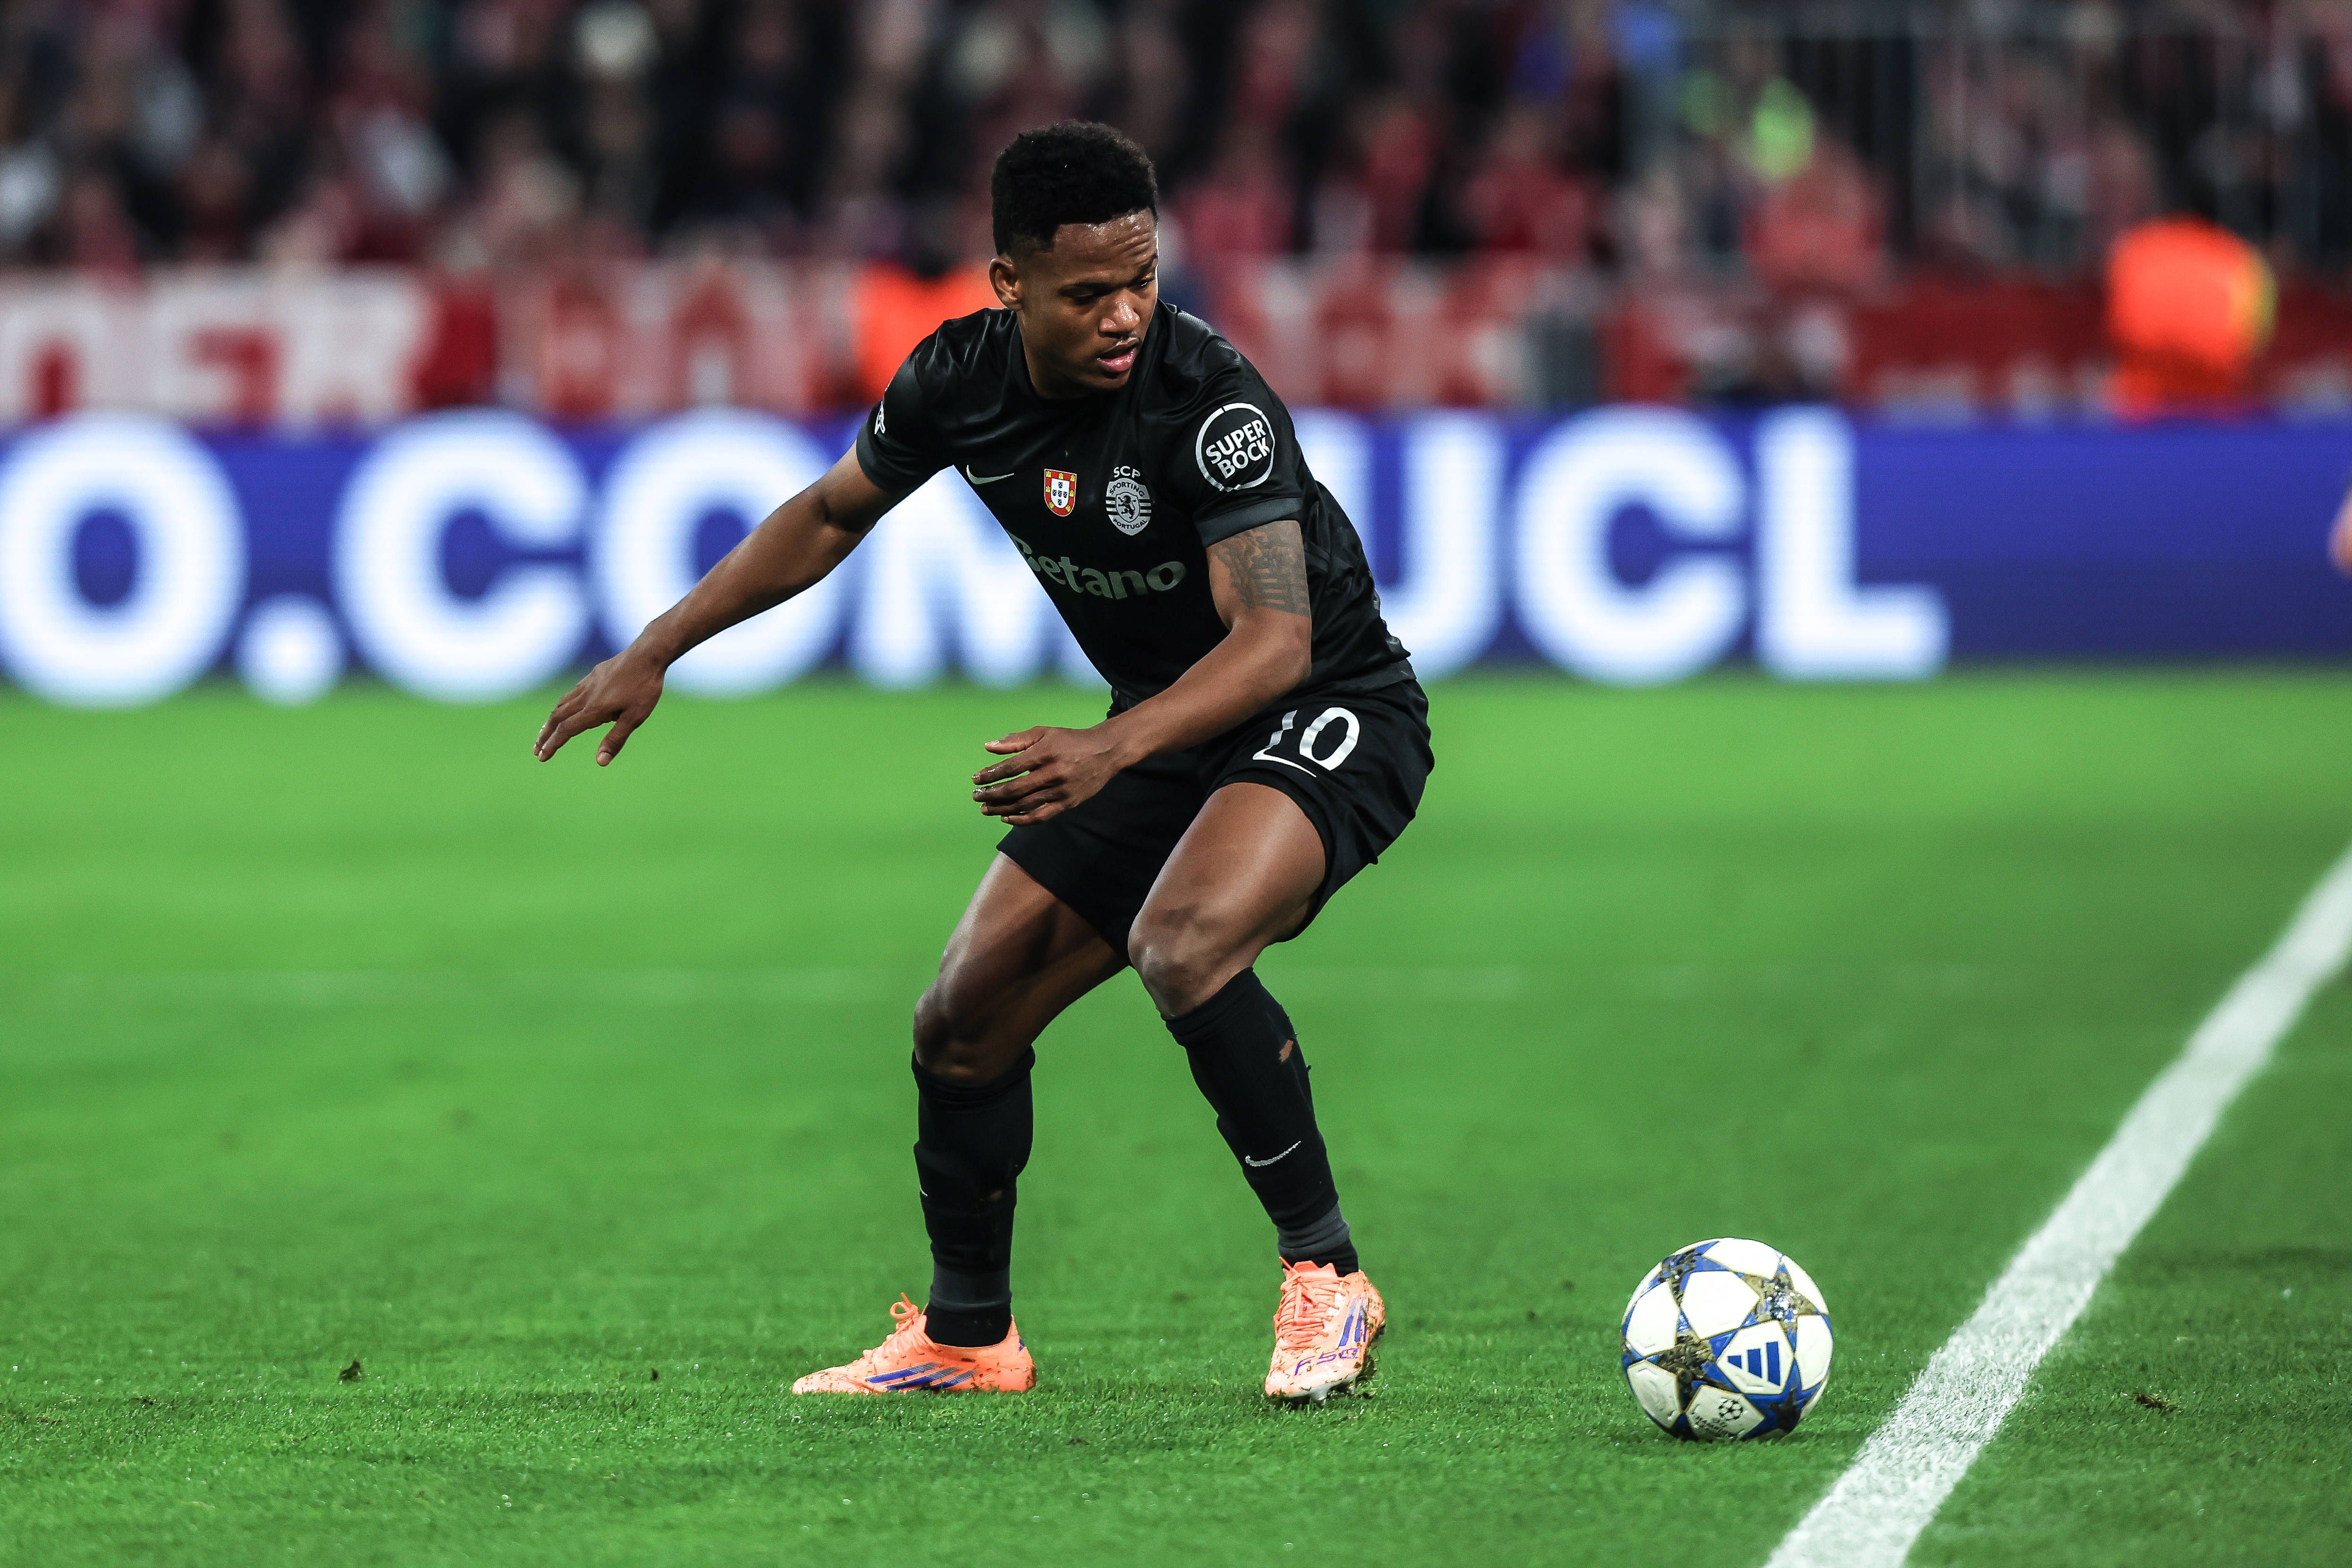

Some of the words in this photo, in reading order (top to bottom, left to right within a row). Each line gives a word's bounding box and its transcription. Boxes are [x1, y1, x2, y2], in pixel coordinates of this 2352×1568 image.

[1206, 420, 1267, 464] SUPER
[1113, 466, 1141, 478] SCP
[1218, 437, 1270, 479] BOCK
[1109, 482, 1145, 497] SPORTING
[1113, 519, 1147, 529] PORTUGAL
[1294, 404, 1949, 683] UCL
